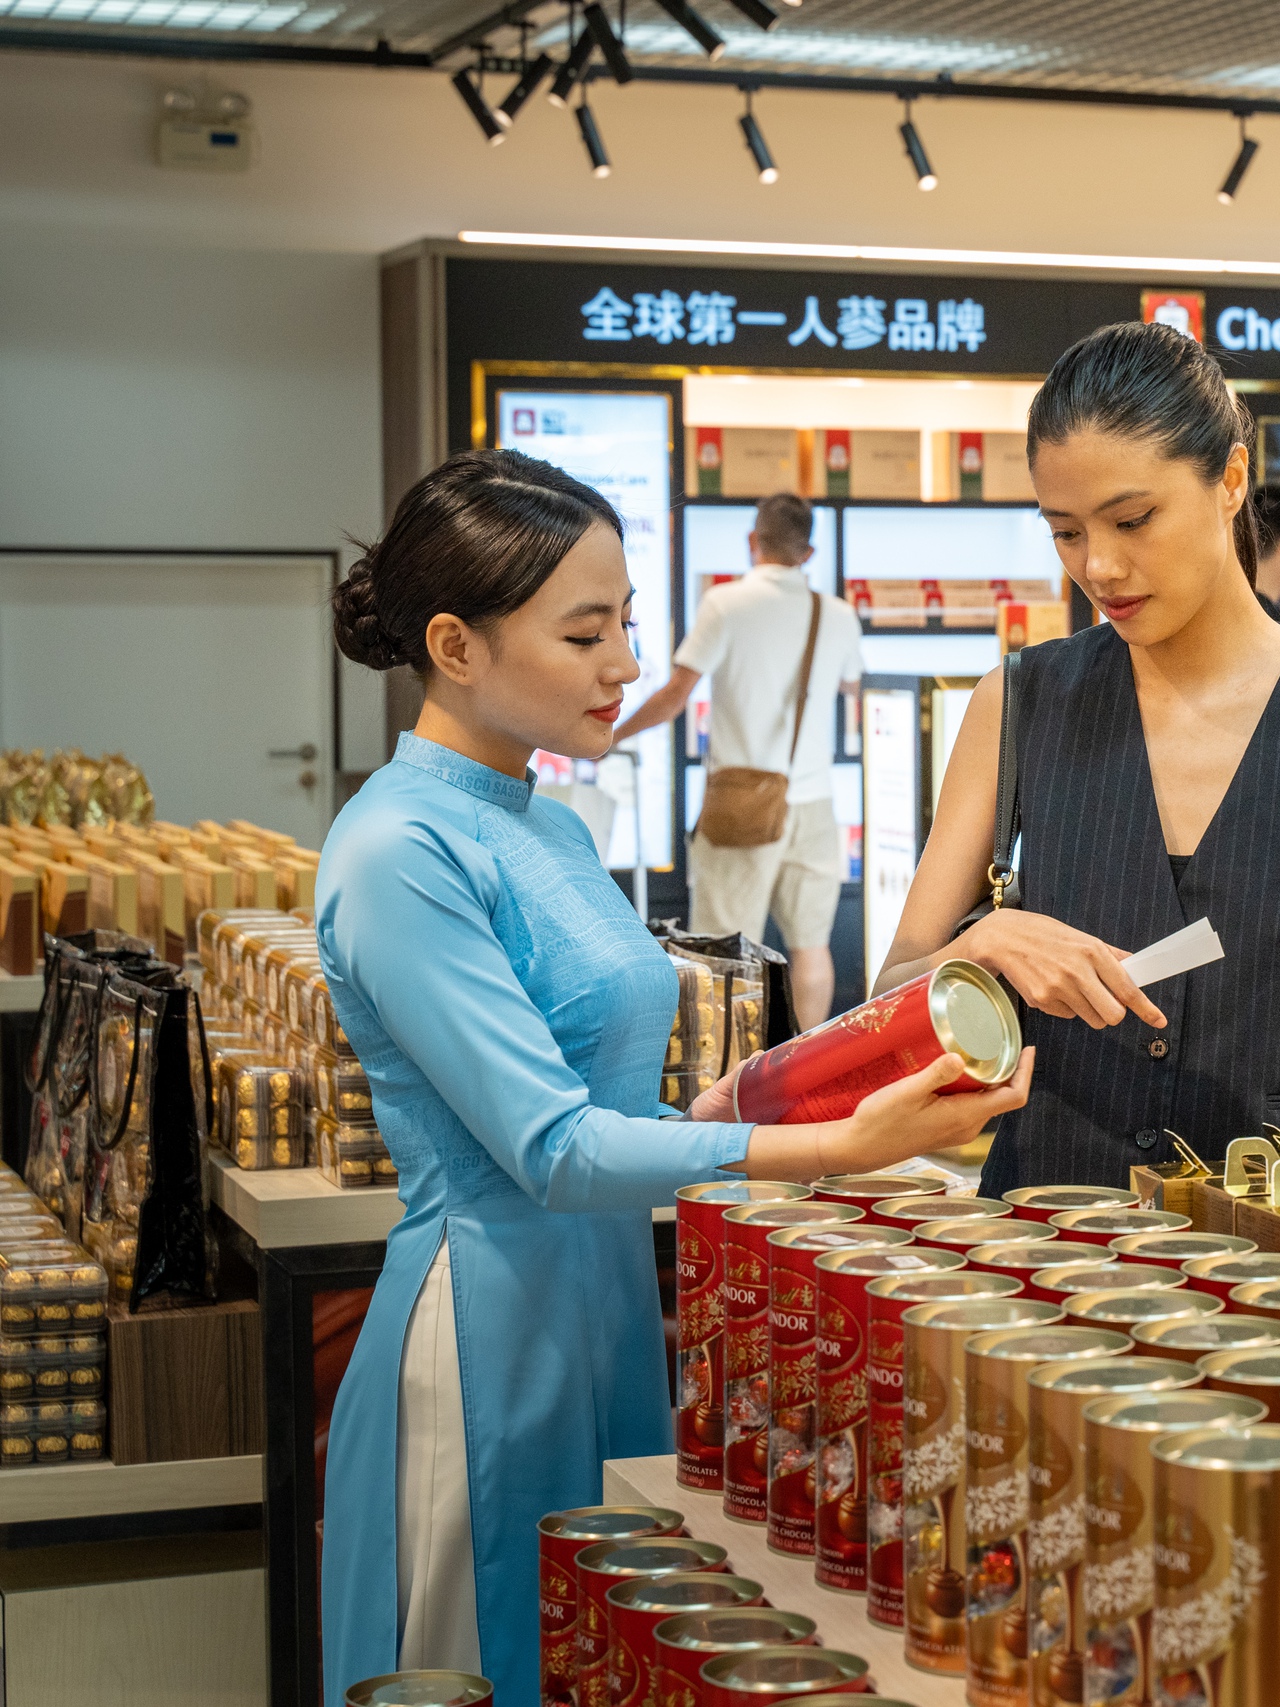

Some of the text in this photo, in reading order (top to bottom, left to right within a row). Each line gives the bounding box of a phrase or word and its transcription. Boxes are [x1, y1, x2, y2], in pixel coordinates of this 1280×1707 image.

[447, 769, 490, 793] SASCO
[493, 783, 528, 801] SASCO
[731, 1494, 768, 1508] CHOCOLA
